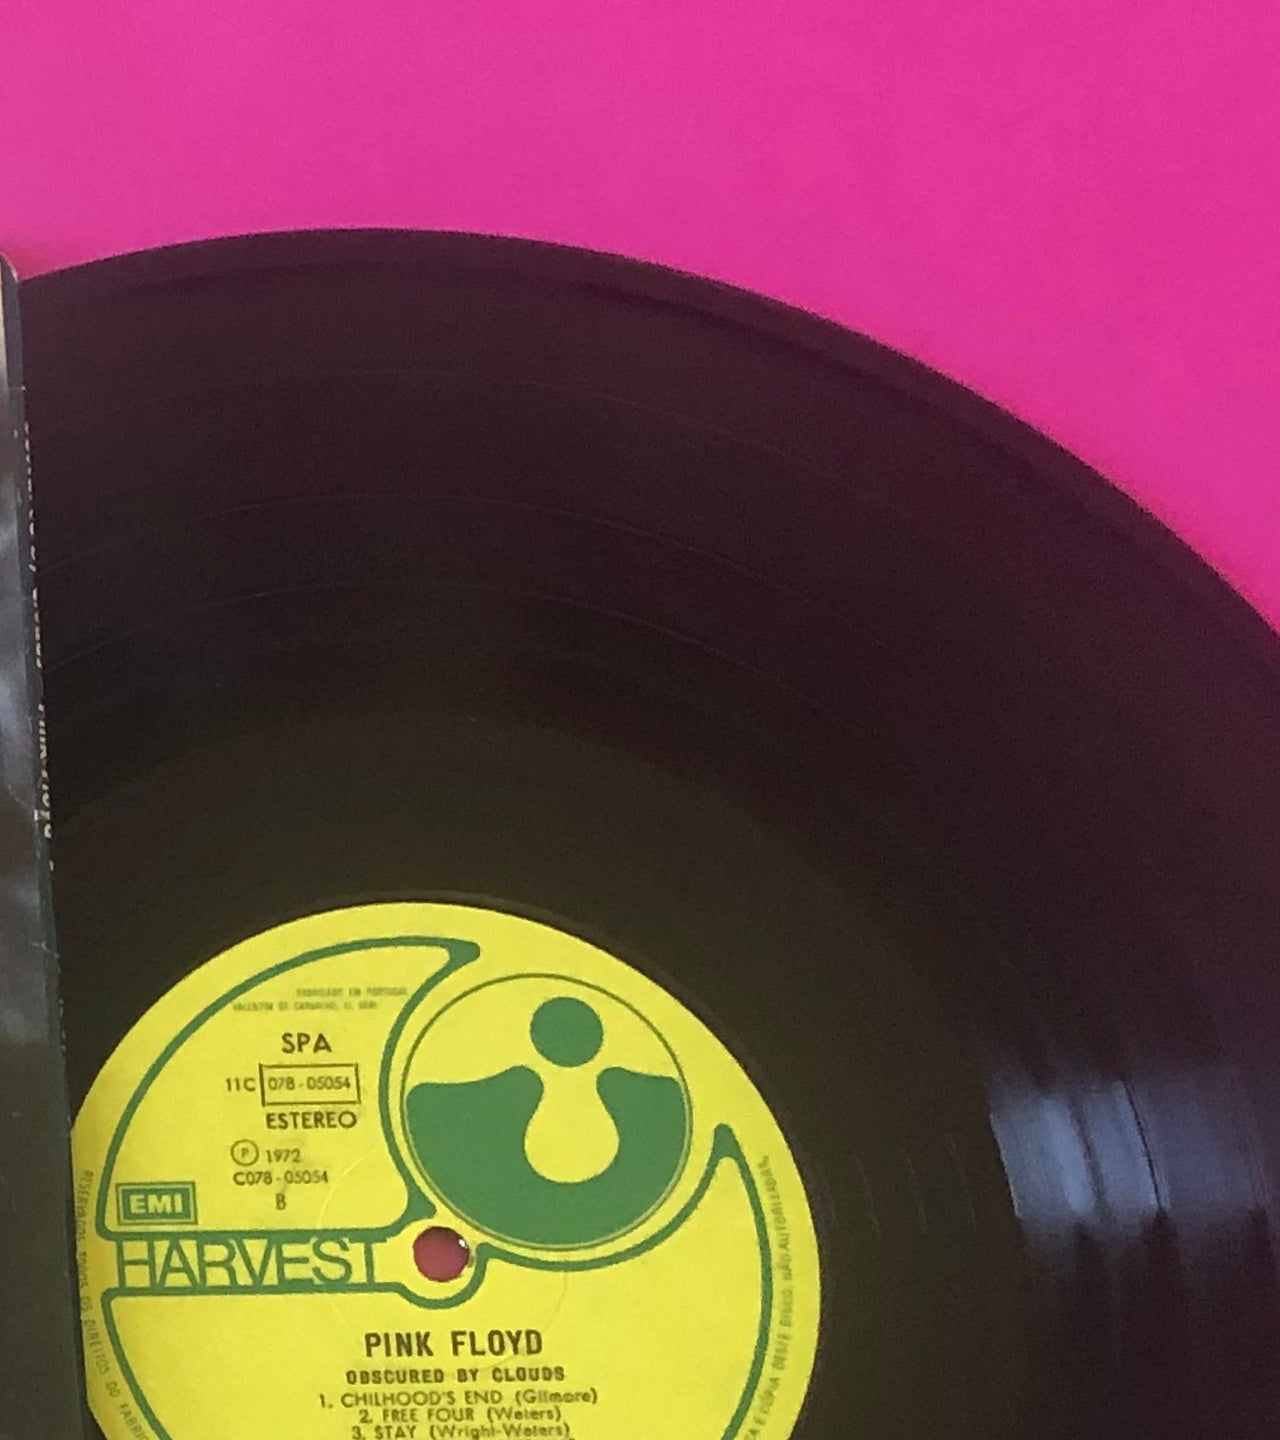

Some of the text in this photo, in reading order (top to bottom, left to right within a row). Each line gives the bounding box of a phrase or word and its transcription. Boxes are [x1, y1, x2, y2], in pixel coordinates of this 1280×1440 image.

[282, 1033, 332, 1054] SPA
[225, 1077, 256, 1092] 11C
[266, 1110, 357, 1130] ESTEREO
[266, 1148, 301, 1164] 1972
[130, 1193, 183, 1215] EMI
[275, 1192, 287, 1210] B
[117, 1236, 387, 1291] HARVEST
[364, 1329, 543, 1358] PINK FLOYD
[345, 1366, 565, 1386] OBSCURED BY CLOUDS
